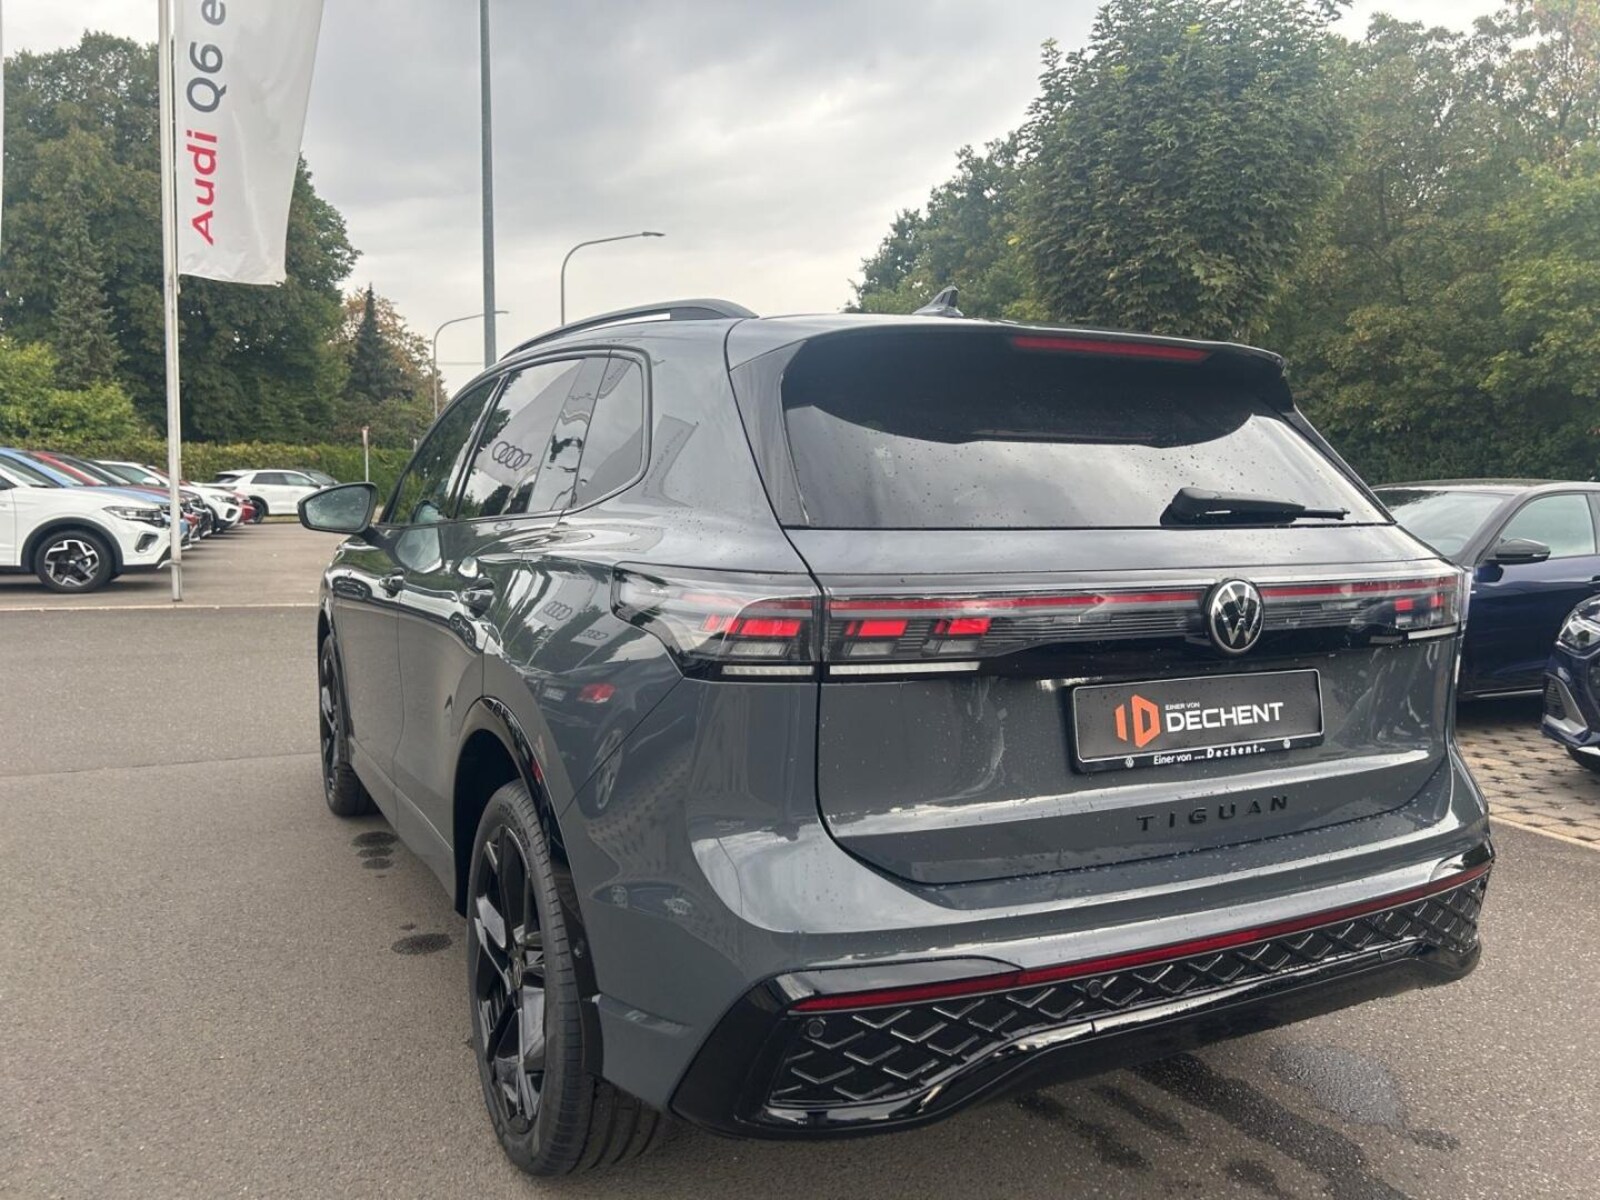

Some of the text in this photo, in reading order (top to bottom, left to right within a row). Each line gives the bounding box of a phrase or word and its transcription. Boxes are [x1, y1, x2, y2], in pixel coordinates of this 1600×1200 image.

[186, 41, 227, 113] Q6
[186, 129, 218, 246] Audi
[1165, 701, 1200, 711] EINER VON
[1165, 702, 1284, 733] DECHENT
[1153, 754, 1174, 765] Einer
[1176, 753, 1192, 762] von
[1136, 795, 1288, 831] TIGUAN
